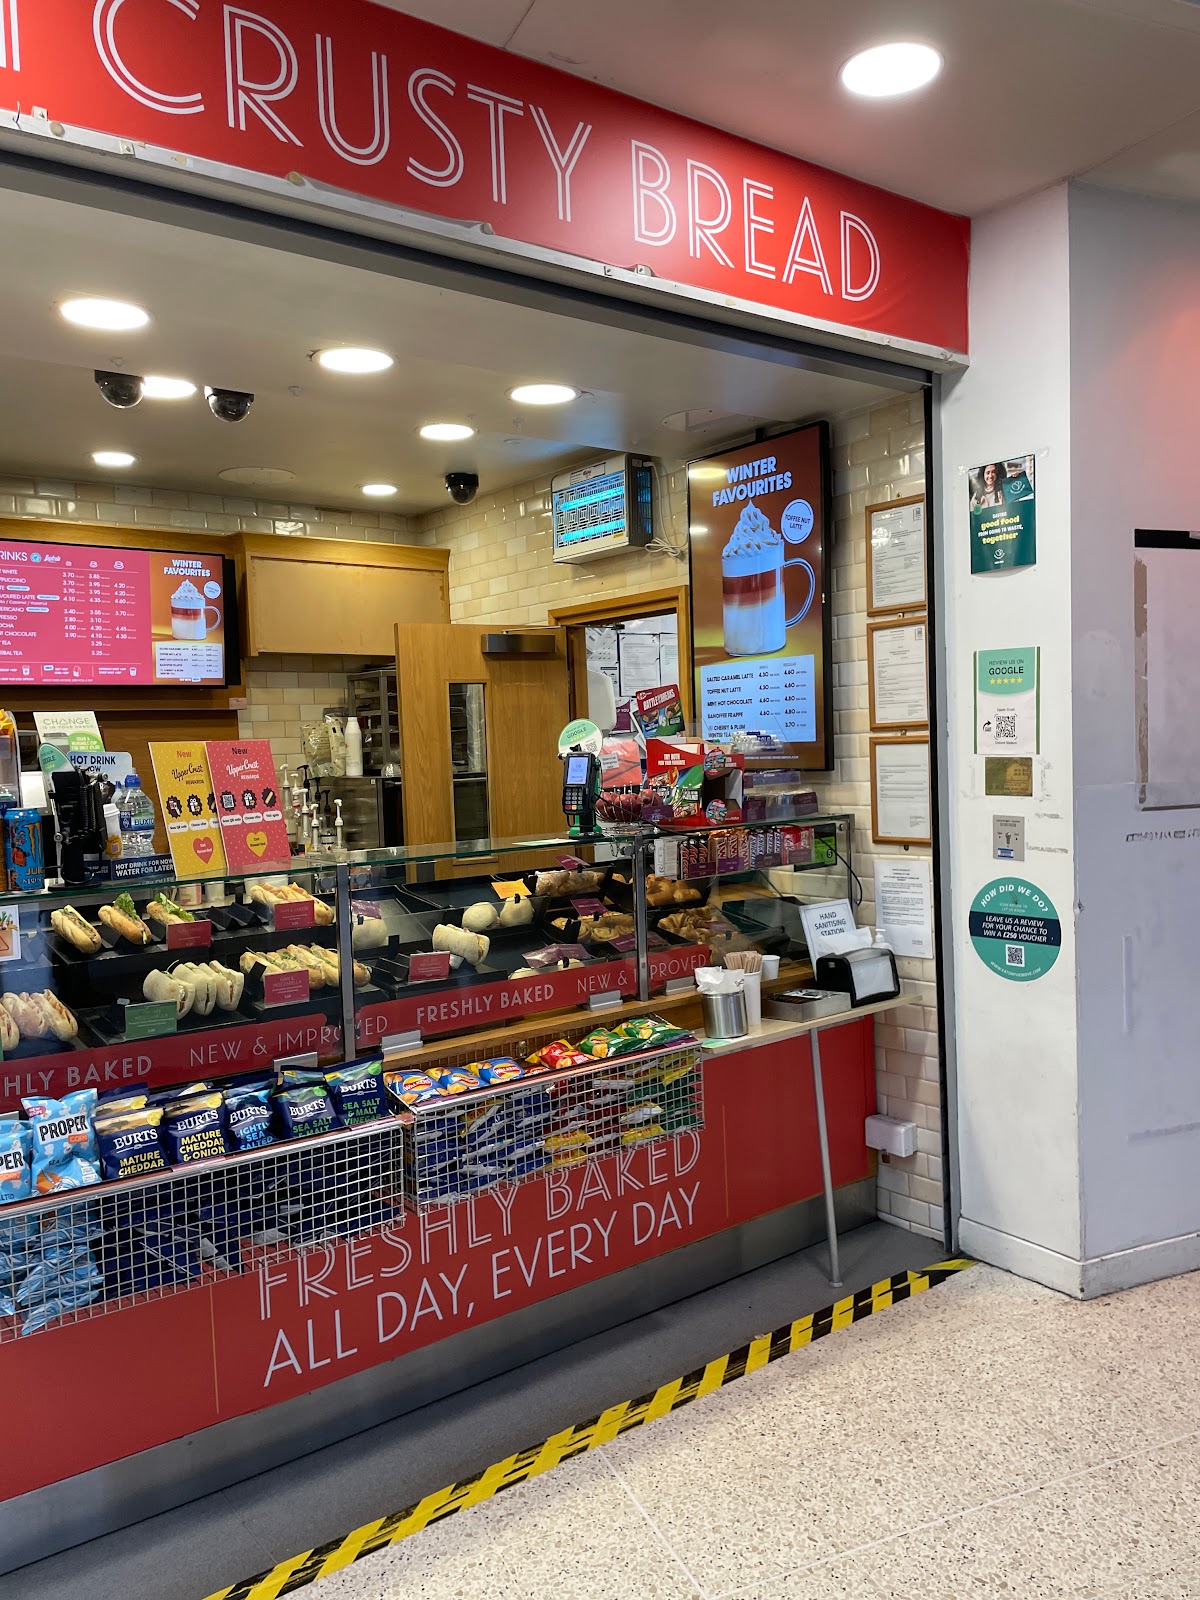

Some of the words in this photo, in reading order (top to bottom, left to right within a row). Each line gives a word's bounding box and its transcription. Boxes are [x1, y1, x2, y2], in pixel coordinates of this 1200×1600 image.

[92, 0, 592, 222] CRUSTY
[631, 139, 881, 301] BREAD
[726, 456, 776, 484] WINTER
[712, 471, 792, 506] FAVOURITES
[785, 514, 800, 522] TOFFEE
[981, 520, 999, 530] good
[1000, 516, 1019, 525] food
[982, 532, 1018, 544] together
[172, 560, 202, 568] WINTER
[164, 568, 210, 577] FAVOURITES
[989, 666, 1024, 675] GOOGLE
[567, 727, 586, 738] GOOGLE
[70, 756, 87, 764] HOT
[91, 756, 116, 764] DRINK
[116, 868, 140, 876] WATER
[981, 888, 997, 907] HOW
[999, 884, 1014, 892] DID
[1018, 886, 1032, 896] WE
[1032, 895, 1048, 912] DO?
[820, 912, 836, 920] HAND
[1020, 919, 1044, 927] REVIEW
[814, 919, 846, 930] SANITISING
[1013, 926, 1038, 934] CHANCE
[821, 928, 844, 936] STATION
[1018, 932, 1047, 942] VOUCHER
[416, 994, 492, 1025] FRESHLY
[500, 983, 554, 1008] BAKED
[577, 973, 612, 994] NEW
[617, 971, 627, 985] &
[634, 954, 707, 985] IPROVED
[4, 1070, 54, 1097] HLY
[67, 1055, 152, 1087] BAKED
[190, 1040, 242, 1066] NEW
[252, 1036, 267, 1055] &
[278, 1016, 388, 1051] IMPRED
[495, 1066, 520, 1074] WALKERS
[340, 1078, 377, 1093] BURTS
[405, 1077, 431, 1091] WALKERS
[290, 1100, 326, 1116] BURTS
[343, 1100, 359, 1110] SEA
[362, 1098, 380, 1108] SALT
[230, 1105, 267, 1123] BURTS
[356, 1106, 378, 1117] MALT
[177, 1110, 219, 1132] BURTS
[293, 1124, 310, 1134] SEA
[312, 1116, 332, 1128] SALT
[344, 1114, 382, 1125] VINEGAR
[39, 1114, 88, 1142] PROPER
[113, 1129, 158, 1150] BURTS
[182, 1129, 221, 1145] MATURE
[240, 1136, 273, 1150] SALTED
[246, 1130, 265, 1142] SEA
[180, 1138, 224, 1155] CHEDDAR
[119, 1150, 160, 1167] MATURE
[184, 1154, 191, 1162] &
[192, 1146, 225, 1160] ONION
[118, 1160, 164, 1177] CHEDDAR
[258, 1184, 520, 1320] FRESHLY
[545, 1131, 701, 1221] BAKED
[264, 1309, 357, 1386] ALL
[376, 1263, 474, 1343] DAY,
[492, 1210, 617, 1298] EVERY
[632, 1181, 700, 1246] DAY
